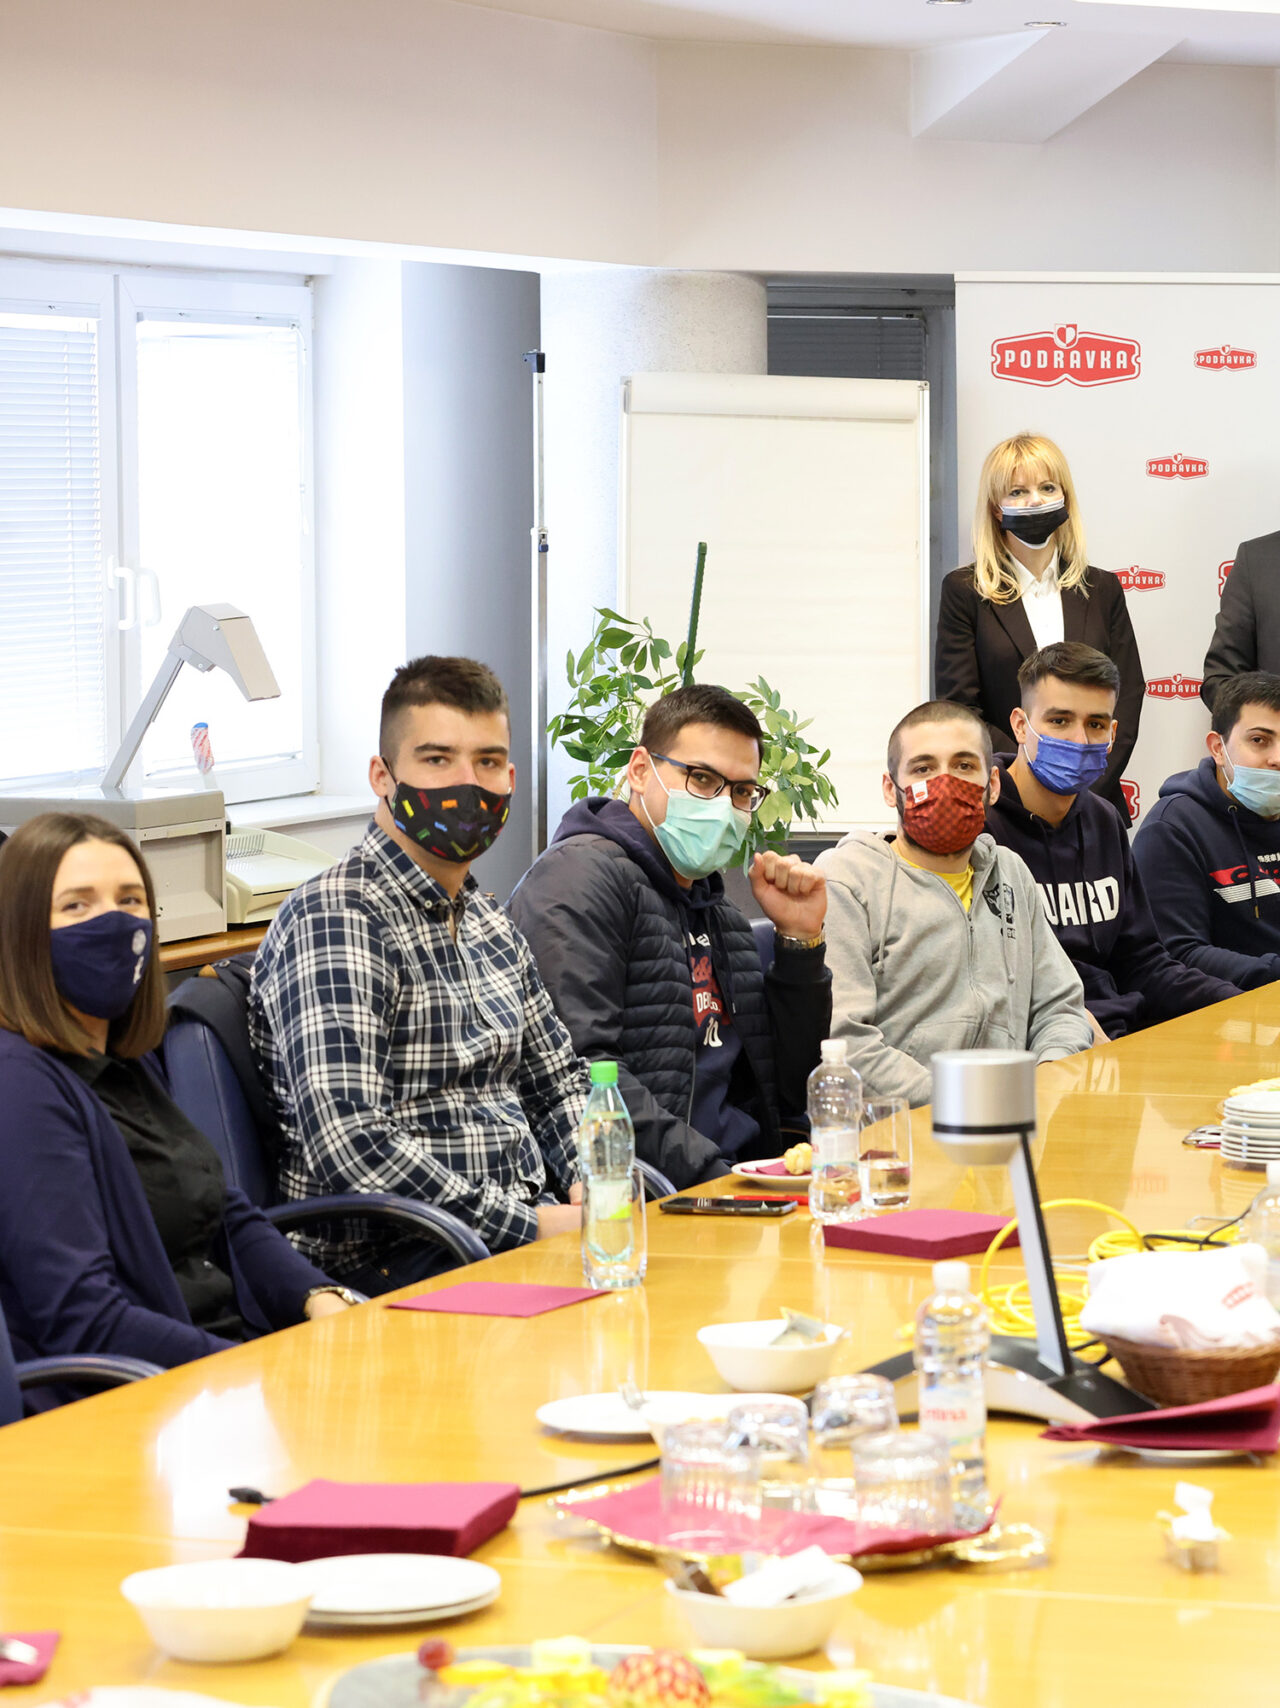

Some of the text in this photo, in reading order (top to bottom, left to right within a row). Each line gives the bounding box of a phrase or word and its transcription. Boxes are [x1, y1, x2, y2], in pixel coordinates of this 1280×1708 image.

[1004, 349, 1128, 370] PODRAVKA
[1199, 354, 1253, 365] PODRAVKA
[1151, 463, 1204, 473] PODRAVKA
